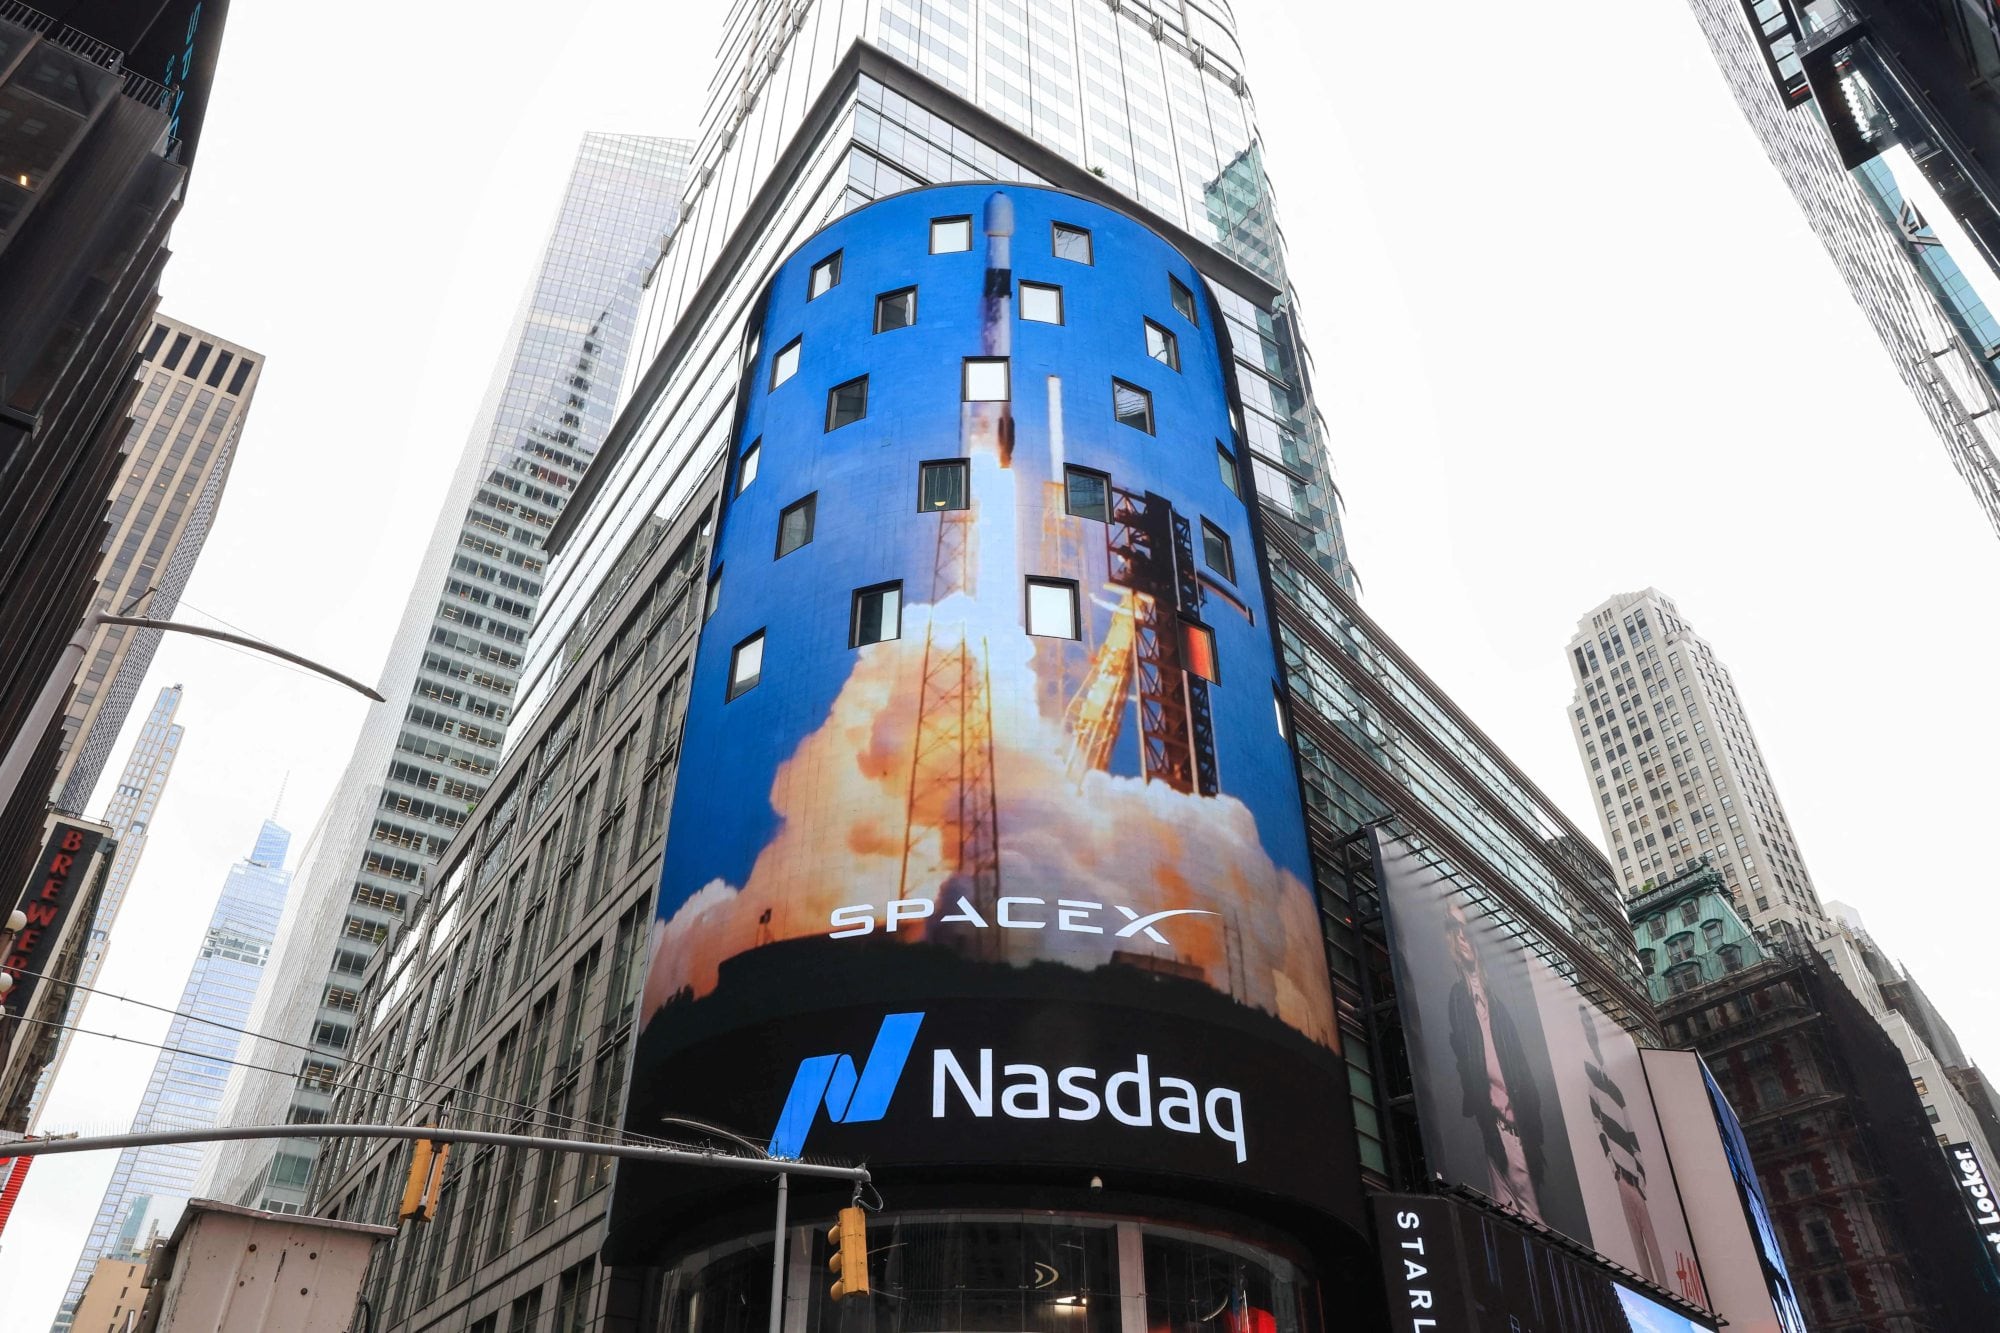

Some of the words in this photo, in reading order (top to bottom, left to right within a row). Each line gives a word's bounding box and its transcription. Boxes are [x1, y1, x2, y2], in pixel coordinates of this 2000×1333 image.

[829, 896, 1221, 945] SPACEX
[932, 1048, 1247, 1164] Nasdaq
[1396, 1211, 1437, 1333] STARL
[1675, 1250, 1706, 1309] H&M
